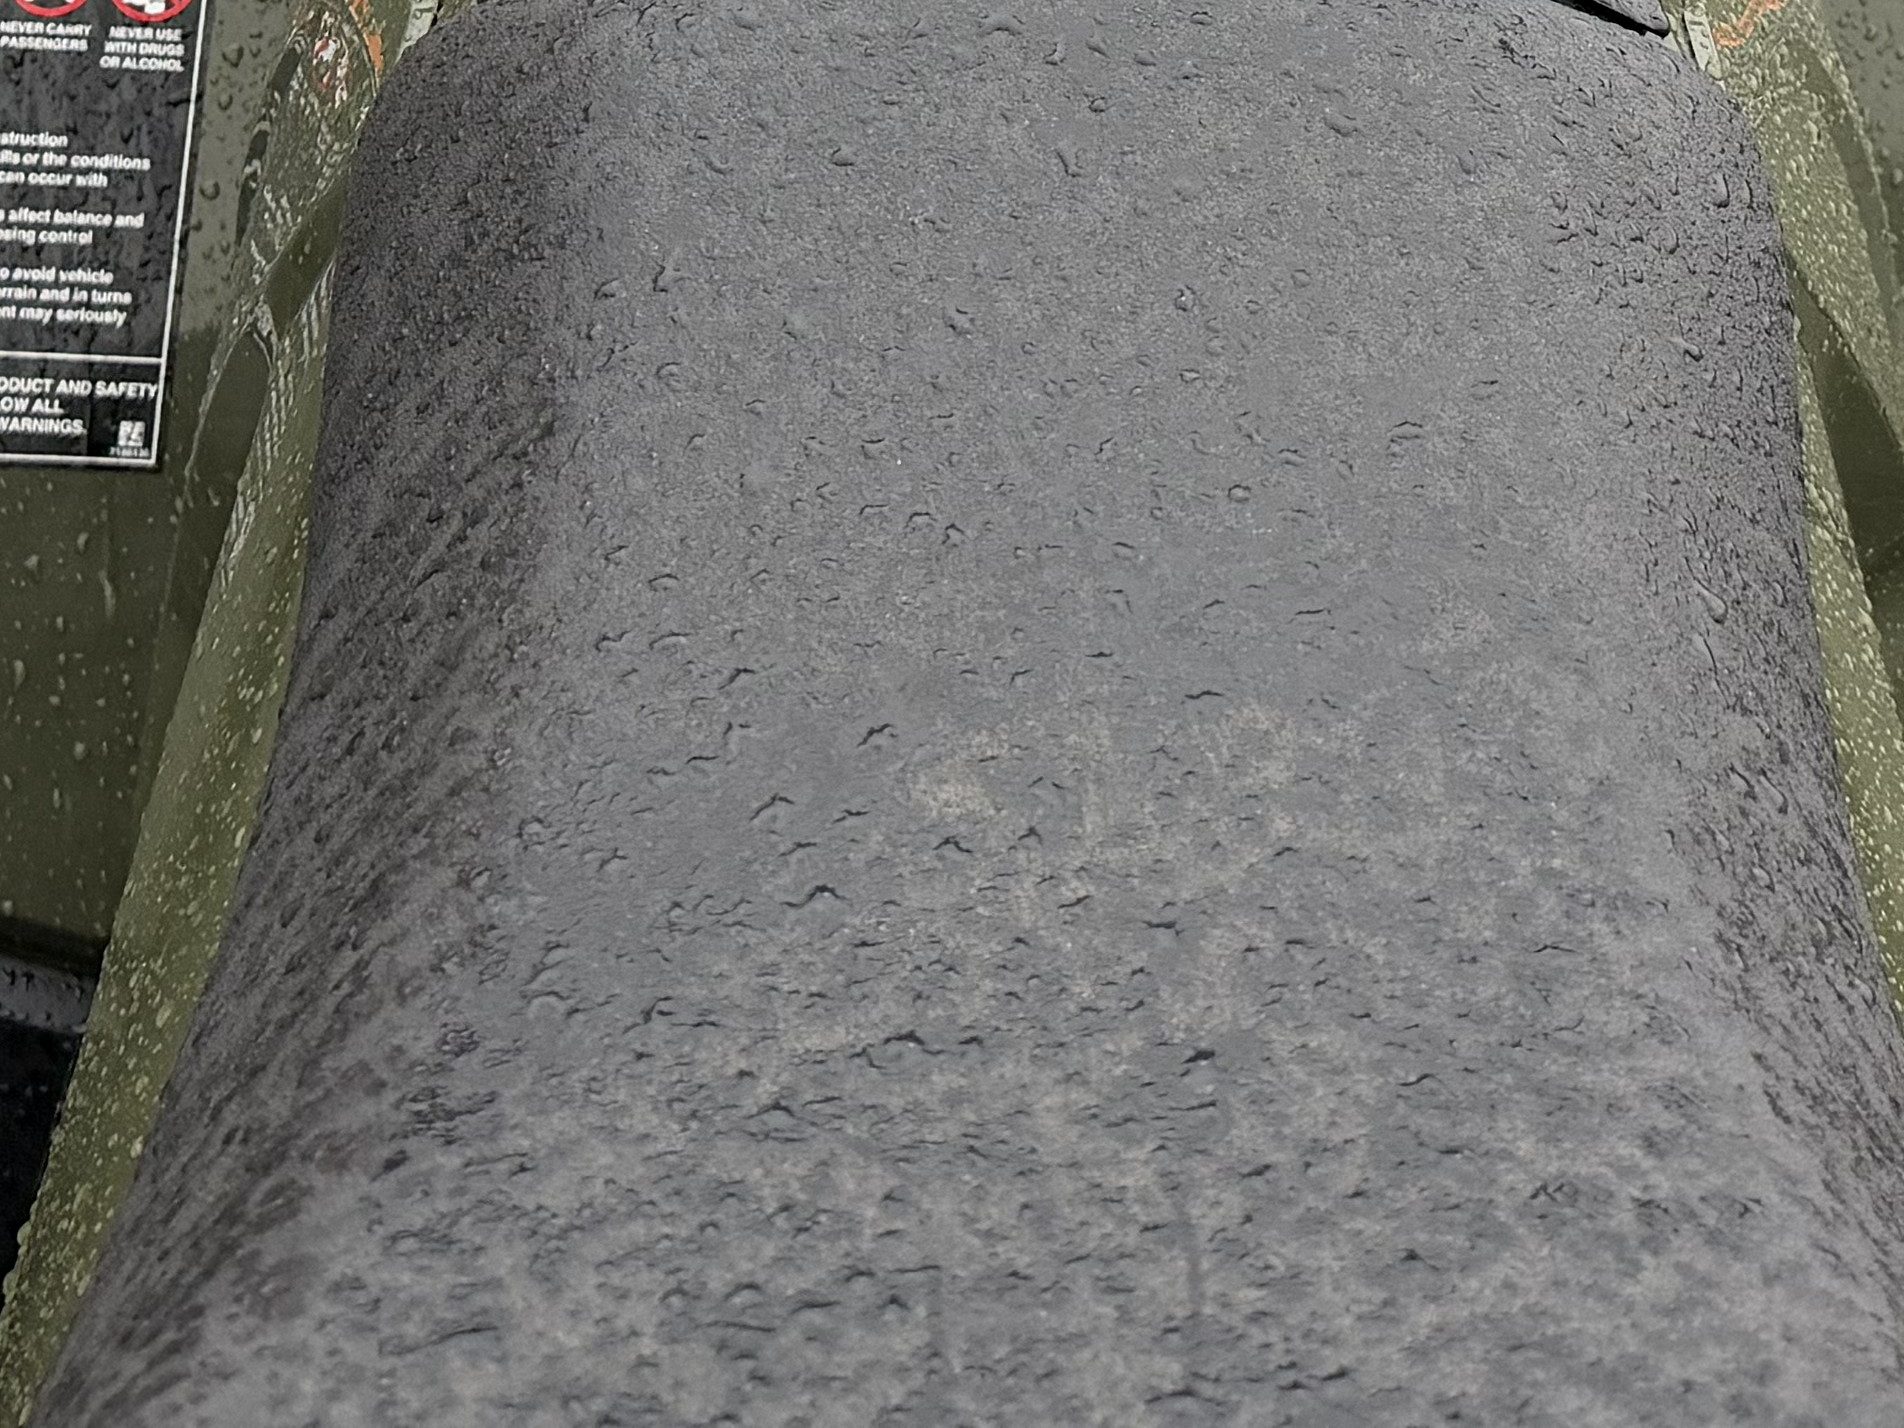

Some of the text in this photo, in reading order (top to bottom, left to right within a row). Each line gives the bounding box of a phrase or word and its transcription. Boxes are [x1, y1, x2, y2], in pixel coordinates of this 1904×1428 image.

[21, 154, 39, 164] or
[41, 152, 68, 165] the
[69, 153, 150, 169] conditions
[55, 379, 92, 396] AND
[93, 380, 157, 399] SAFETY
[30, 398, 63, 414] ALL
